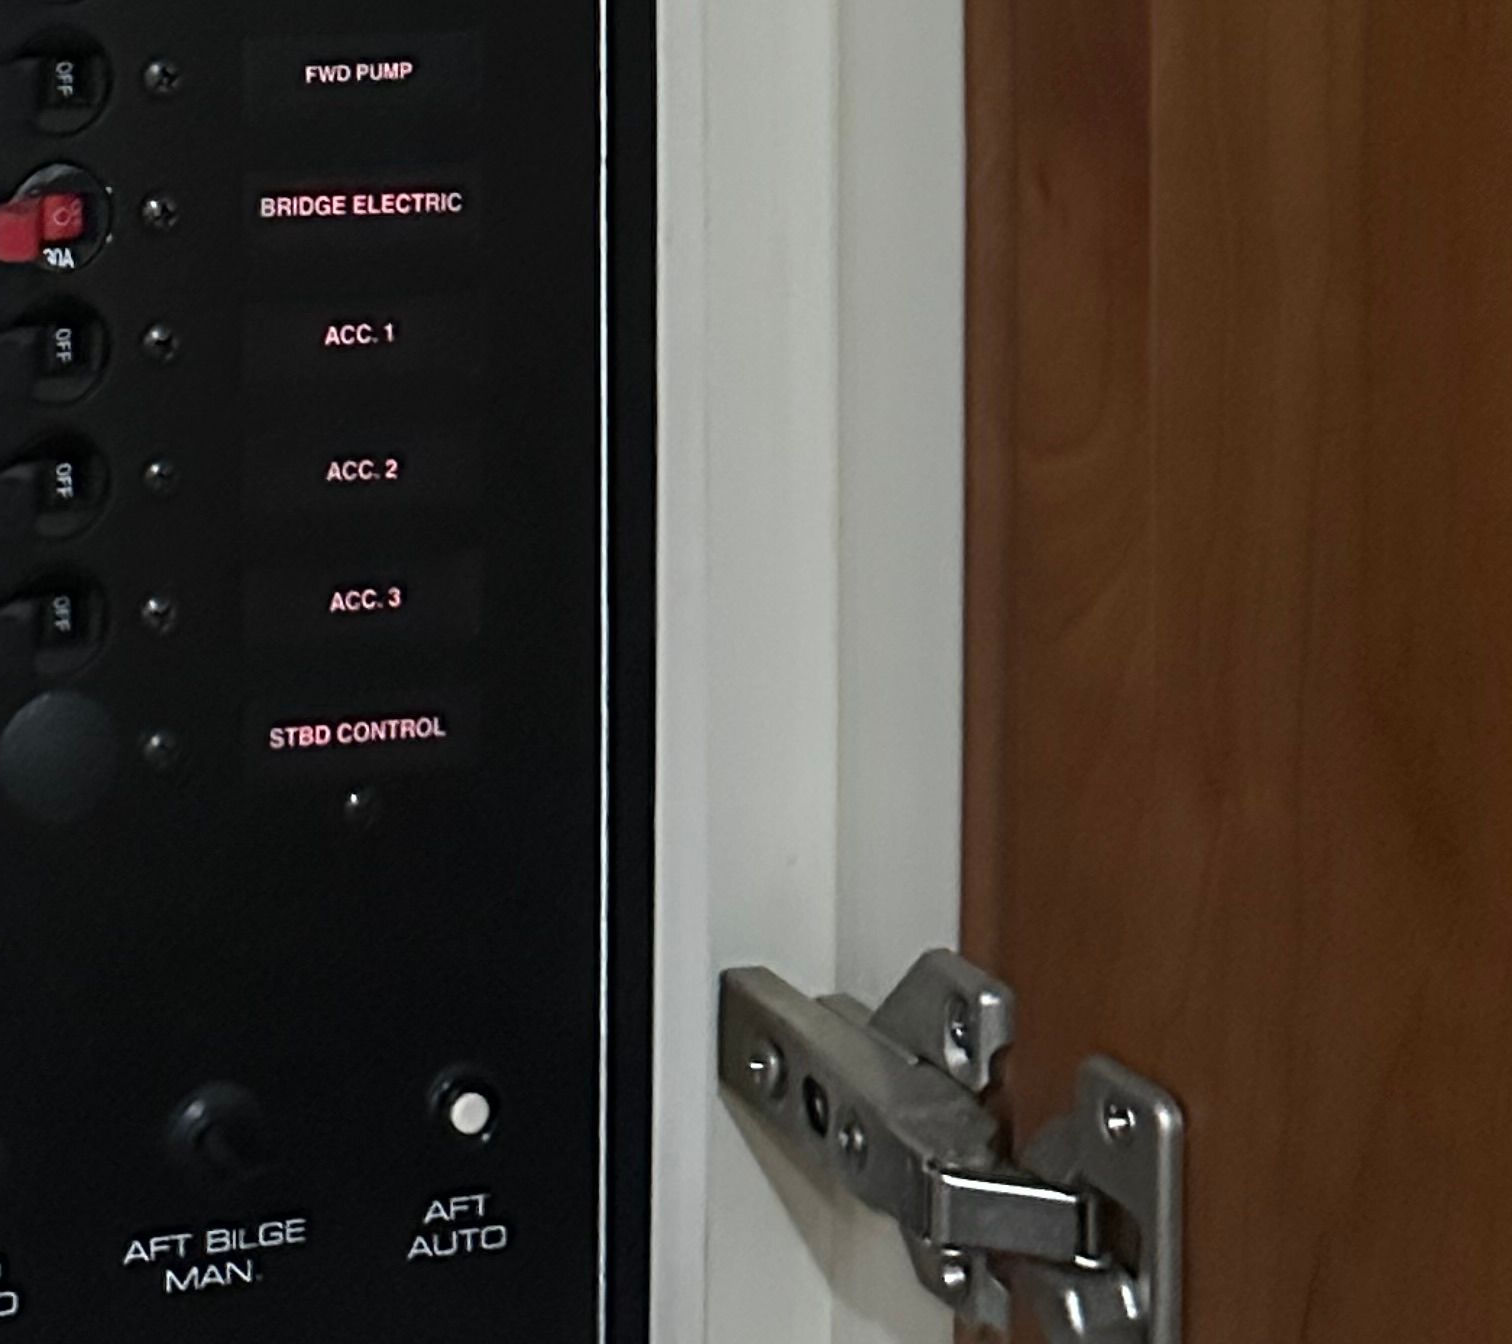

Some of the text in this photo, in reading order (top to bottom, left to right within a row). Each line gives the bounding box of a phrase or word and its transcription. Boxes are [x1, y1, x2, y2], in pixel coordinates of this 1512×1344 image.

[55, 61, 74, 97] OFF
[304, 61, 413, 84] FWD PUMP
[260, 192, 462, 218] BRIDGE ELECTRIC
[54, 328, 72, 362] OFF
[324, 322, 394, 346] ACC. 1
[55, 462, 74, 498] OFF
[326, 458, 398, 482] ACC. 2
[52, 596, 71, 632] OFF
[329, 586, 402, 613] ACC. 3
[269, 716, 446, 749] STBD CONTROL
[423, 1194, 488, 1224] AFT
[123, 1218, 307, 1265] AFT BILGE
[407, 1224, 508, 1261] AUTO
